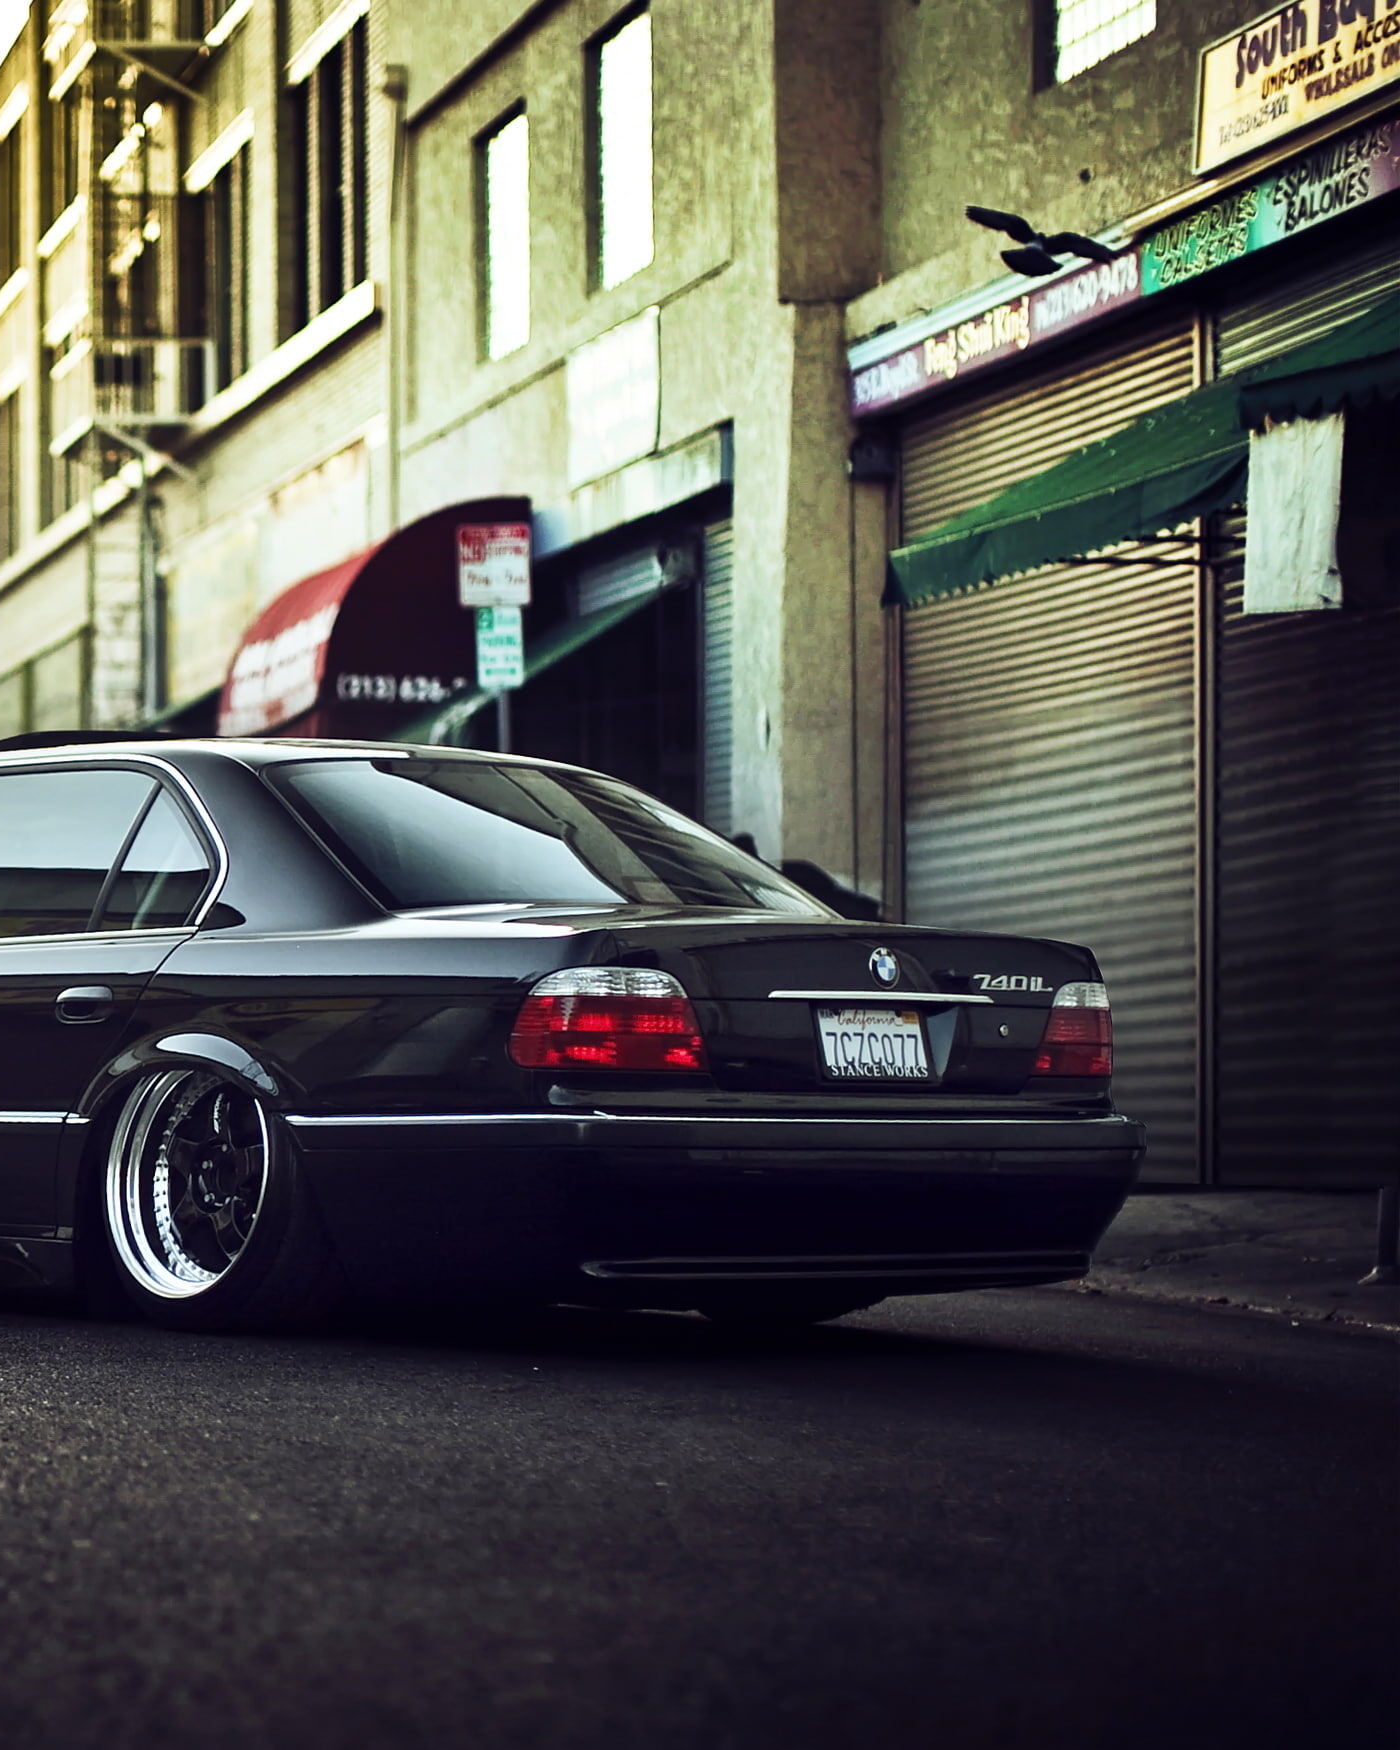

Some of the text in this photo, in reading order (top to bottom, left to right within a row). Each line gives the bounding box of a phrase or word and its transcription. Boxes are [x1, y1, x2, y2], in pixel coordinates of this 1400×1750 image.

[1285, 165, 1370, 232] BALONES
[837, 1008, 903, 1031] California
[825, 1032, 919, 1067] 7CZC077
